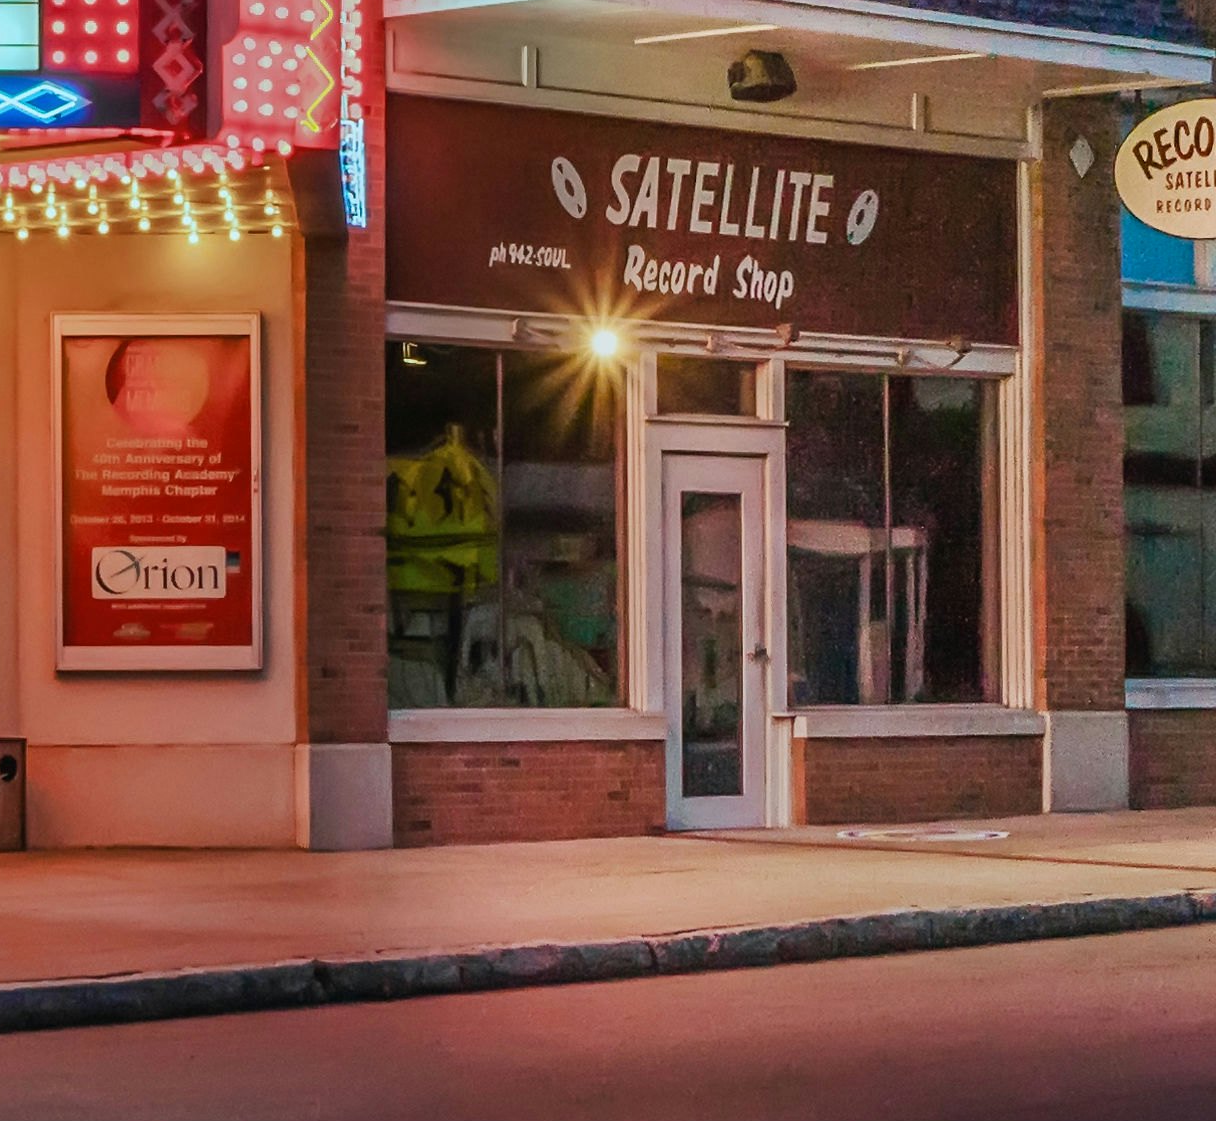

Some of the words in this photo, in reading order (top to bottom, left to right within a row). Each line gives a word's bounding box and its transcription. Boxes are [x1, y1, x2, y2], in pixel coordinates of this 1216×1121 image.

[605, 153, 835, 244] SATELLITE
[1156, 199, 1212, 214] RECORD
[623, 244, 721, 296] Record
[732, 254, 795, 310] Shop
[106, 437, 183, 451] Celebrating
[186, 437, 209, 449] the
[125, 453, 205, 467] Anniversary
[208, 452, 222, 464] of
[74, 469, 97, 480] The
[102, 469, 171, 483] Recording
[101, 484, 161, 498] Memphis
[164, 484, 219, 498] Chapter
[95, 549, 220, 596] Orion
